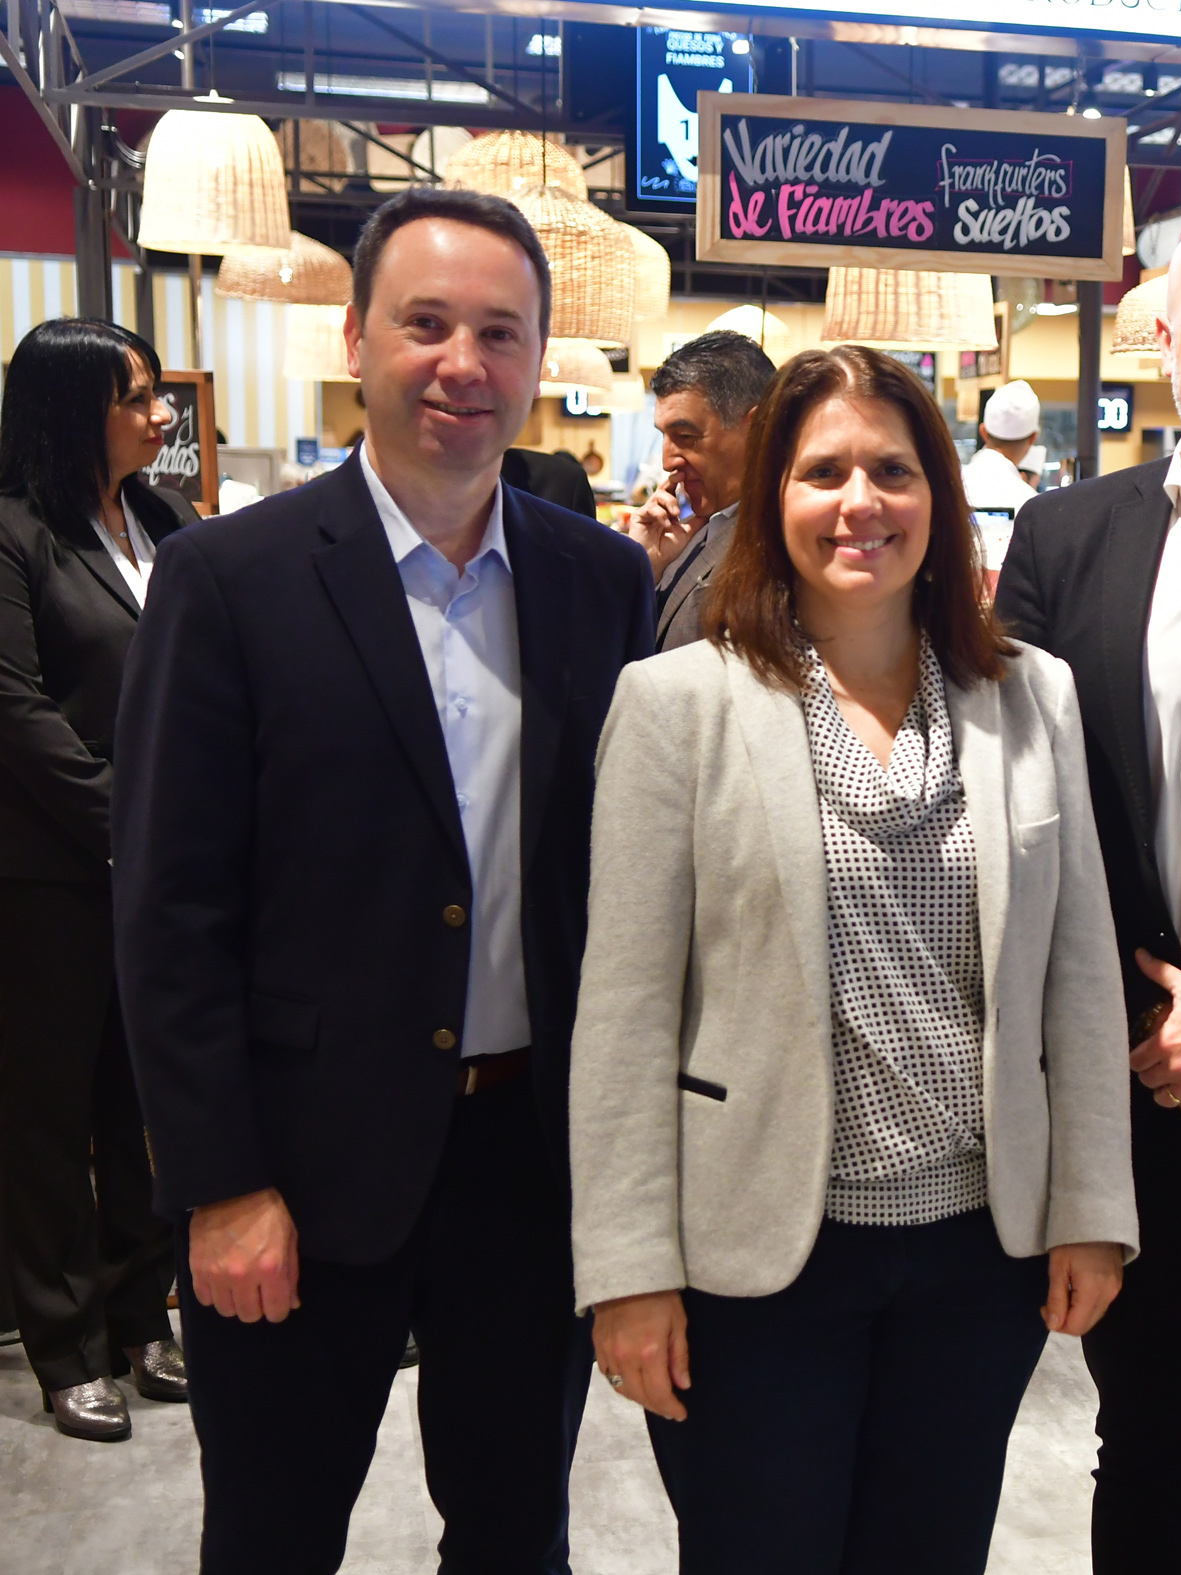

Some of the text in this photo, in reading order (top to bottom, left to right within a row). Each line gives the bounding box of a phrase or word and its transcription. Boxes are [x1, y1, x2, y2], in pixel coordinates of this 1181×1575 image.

[665, 51, 725, 69] FIAMBRES
[723, 117, 894, 187] Variedad
[728, 170, 935, 243] de Fiambres
[953, 197, 1072, 250] Sueltos
